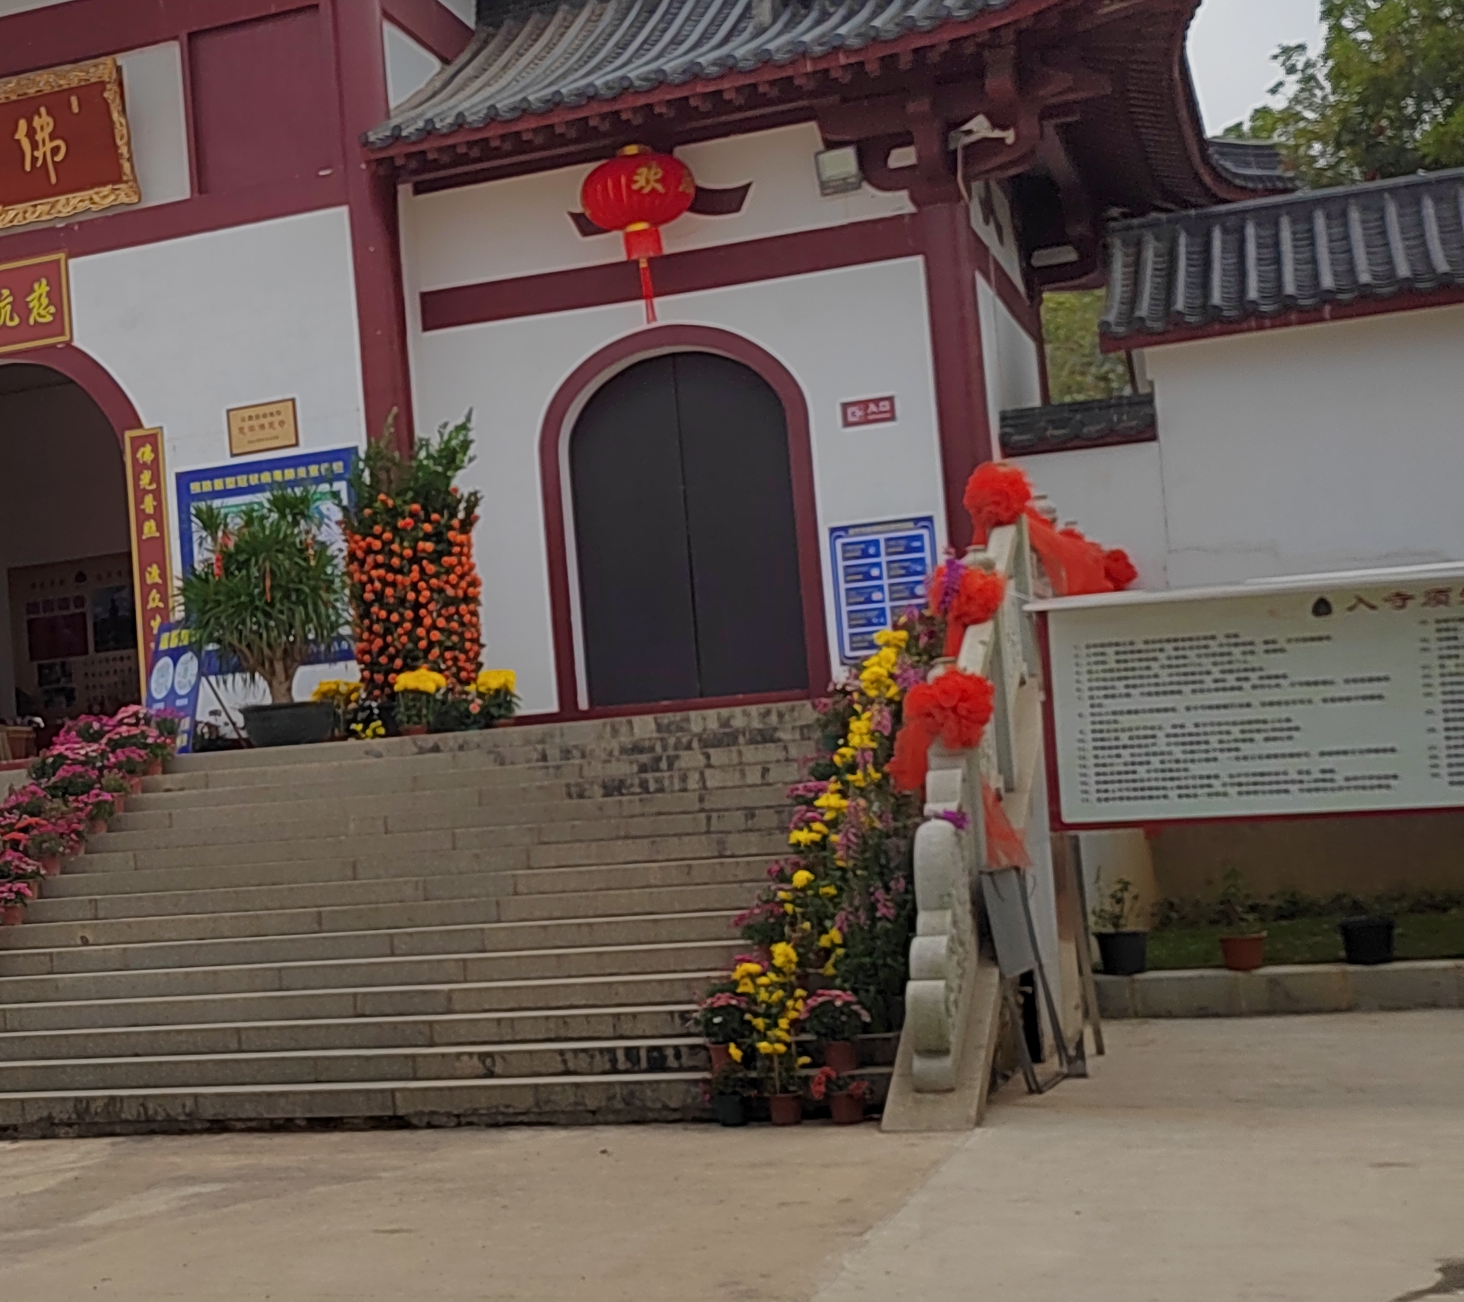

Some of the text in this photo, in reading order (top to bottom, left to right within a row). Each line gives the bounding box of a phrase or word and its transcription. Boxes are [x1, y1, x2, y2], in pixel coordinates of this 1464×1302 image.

[136, 443, 160, 539] 佛光普照
[1346, 587, 1464, 612] 入寺须
